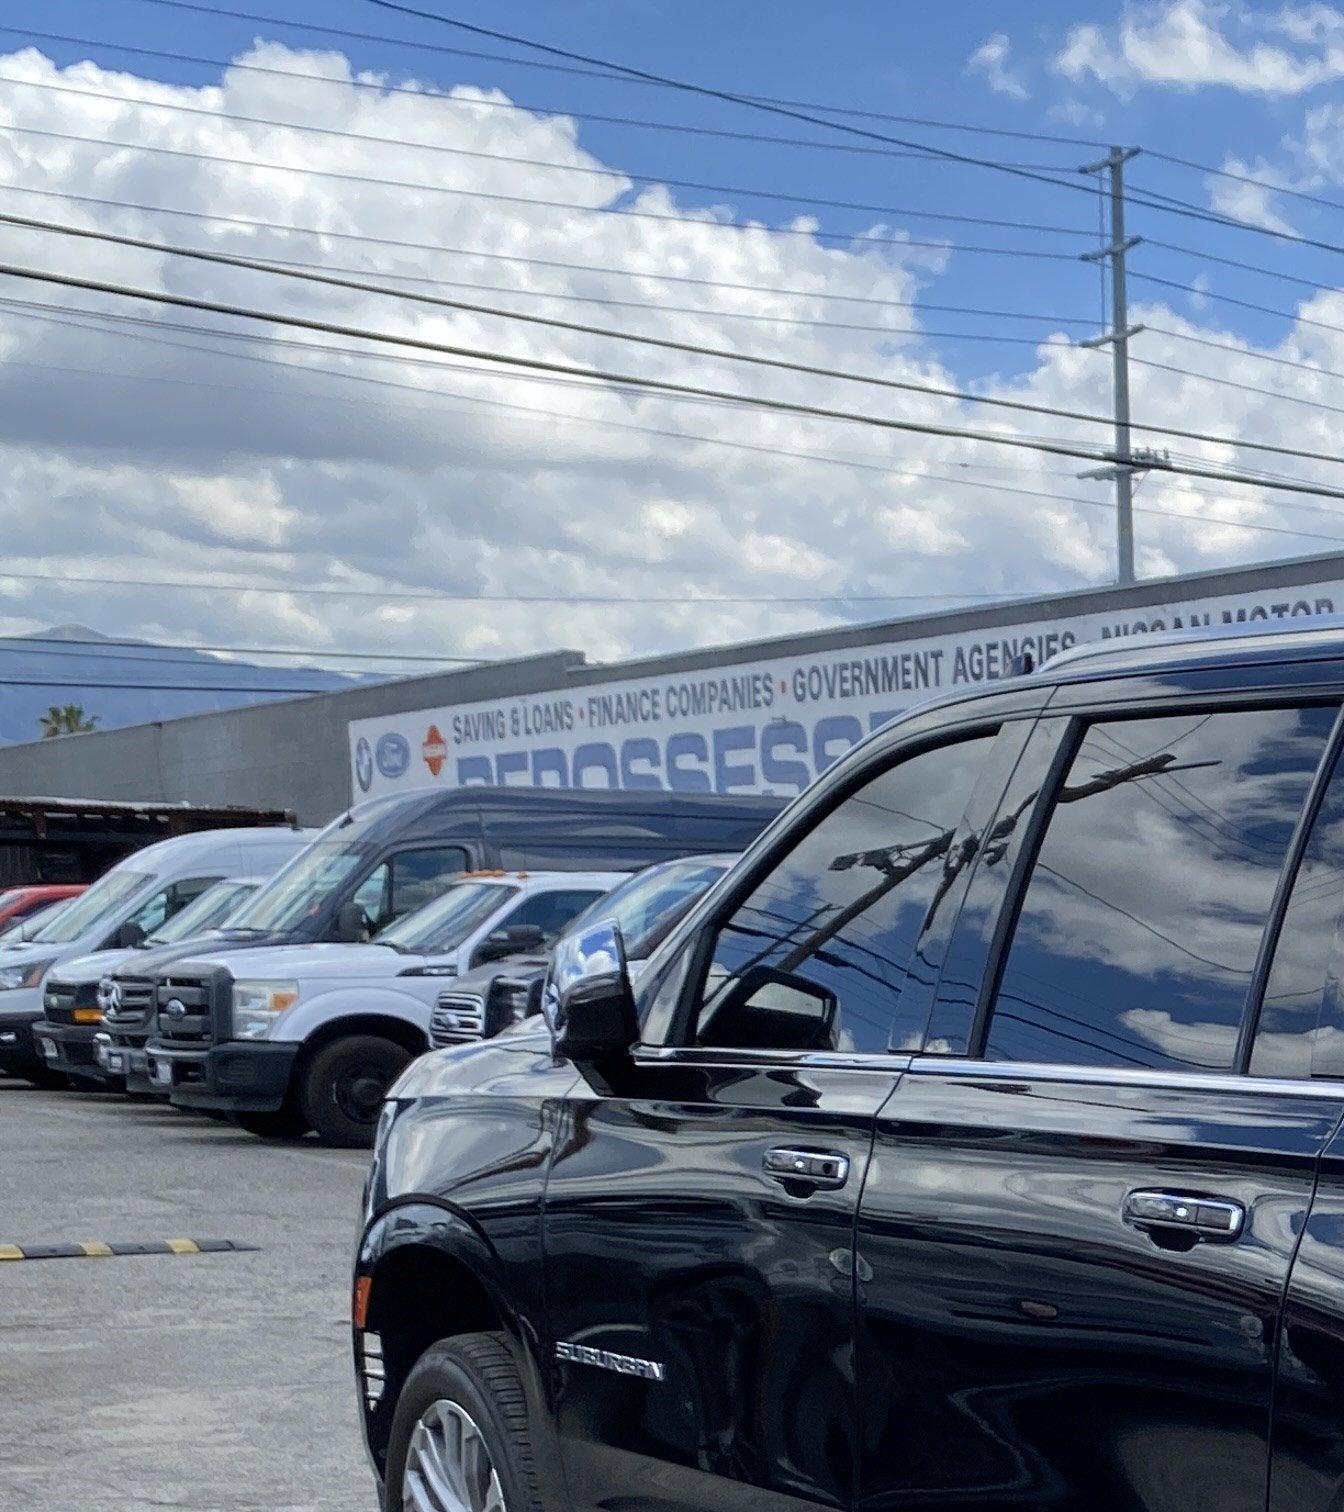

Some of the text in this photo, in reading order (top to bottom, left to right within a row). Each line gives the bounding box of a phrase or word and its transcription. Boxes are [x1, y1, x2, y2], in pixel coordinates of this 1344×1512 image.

[453, 709, 506, 745] SAVING
[510, 713, 521, 737] &
[524, 701, 574, 735] LOANS
[588, 688, 661, 728] FINANCE
[666, 672, 774, 718] COMPANIES
[793, 650, 943, 703] GOVERNMENT
[554, 1341, 665, 1381] SUBURBAN
